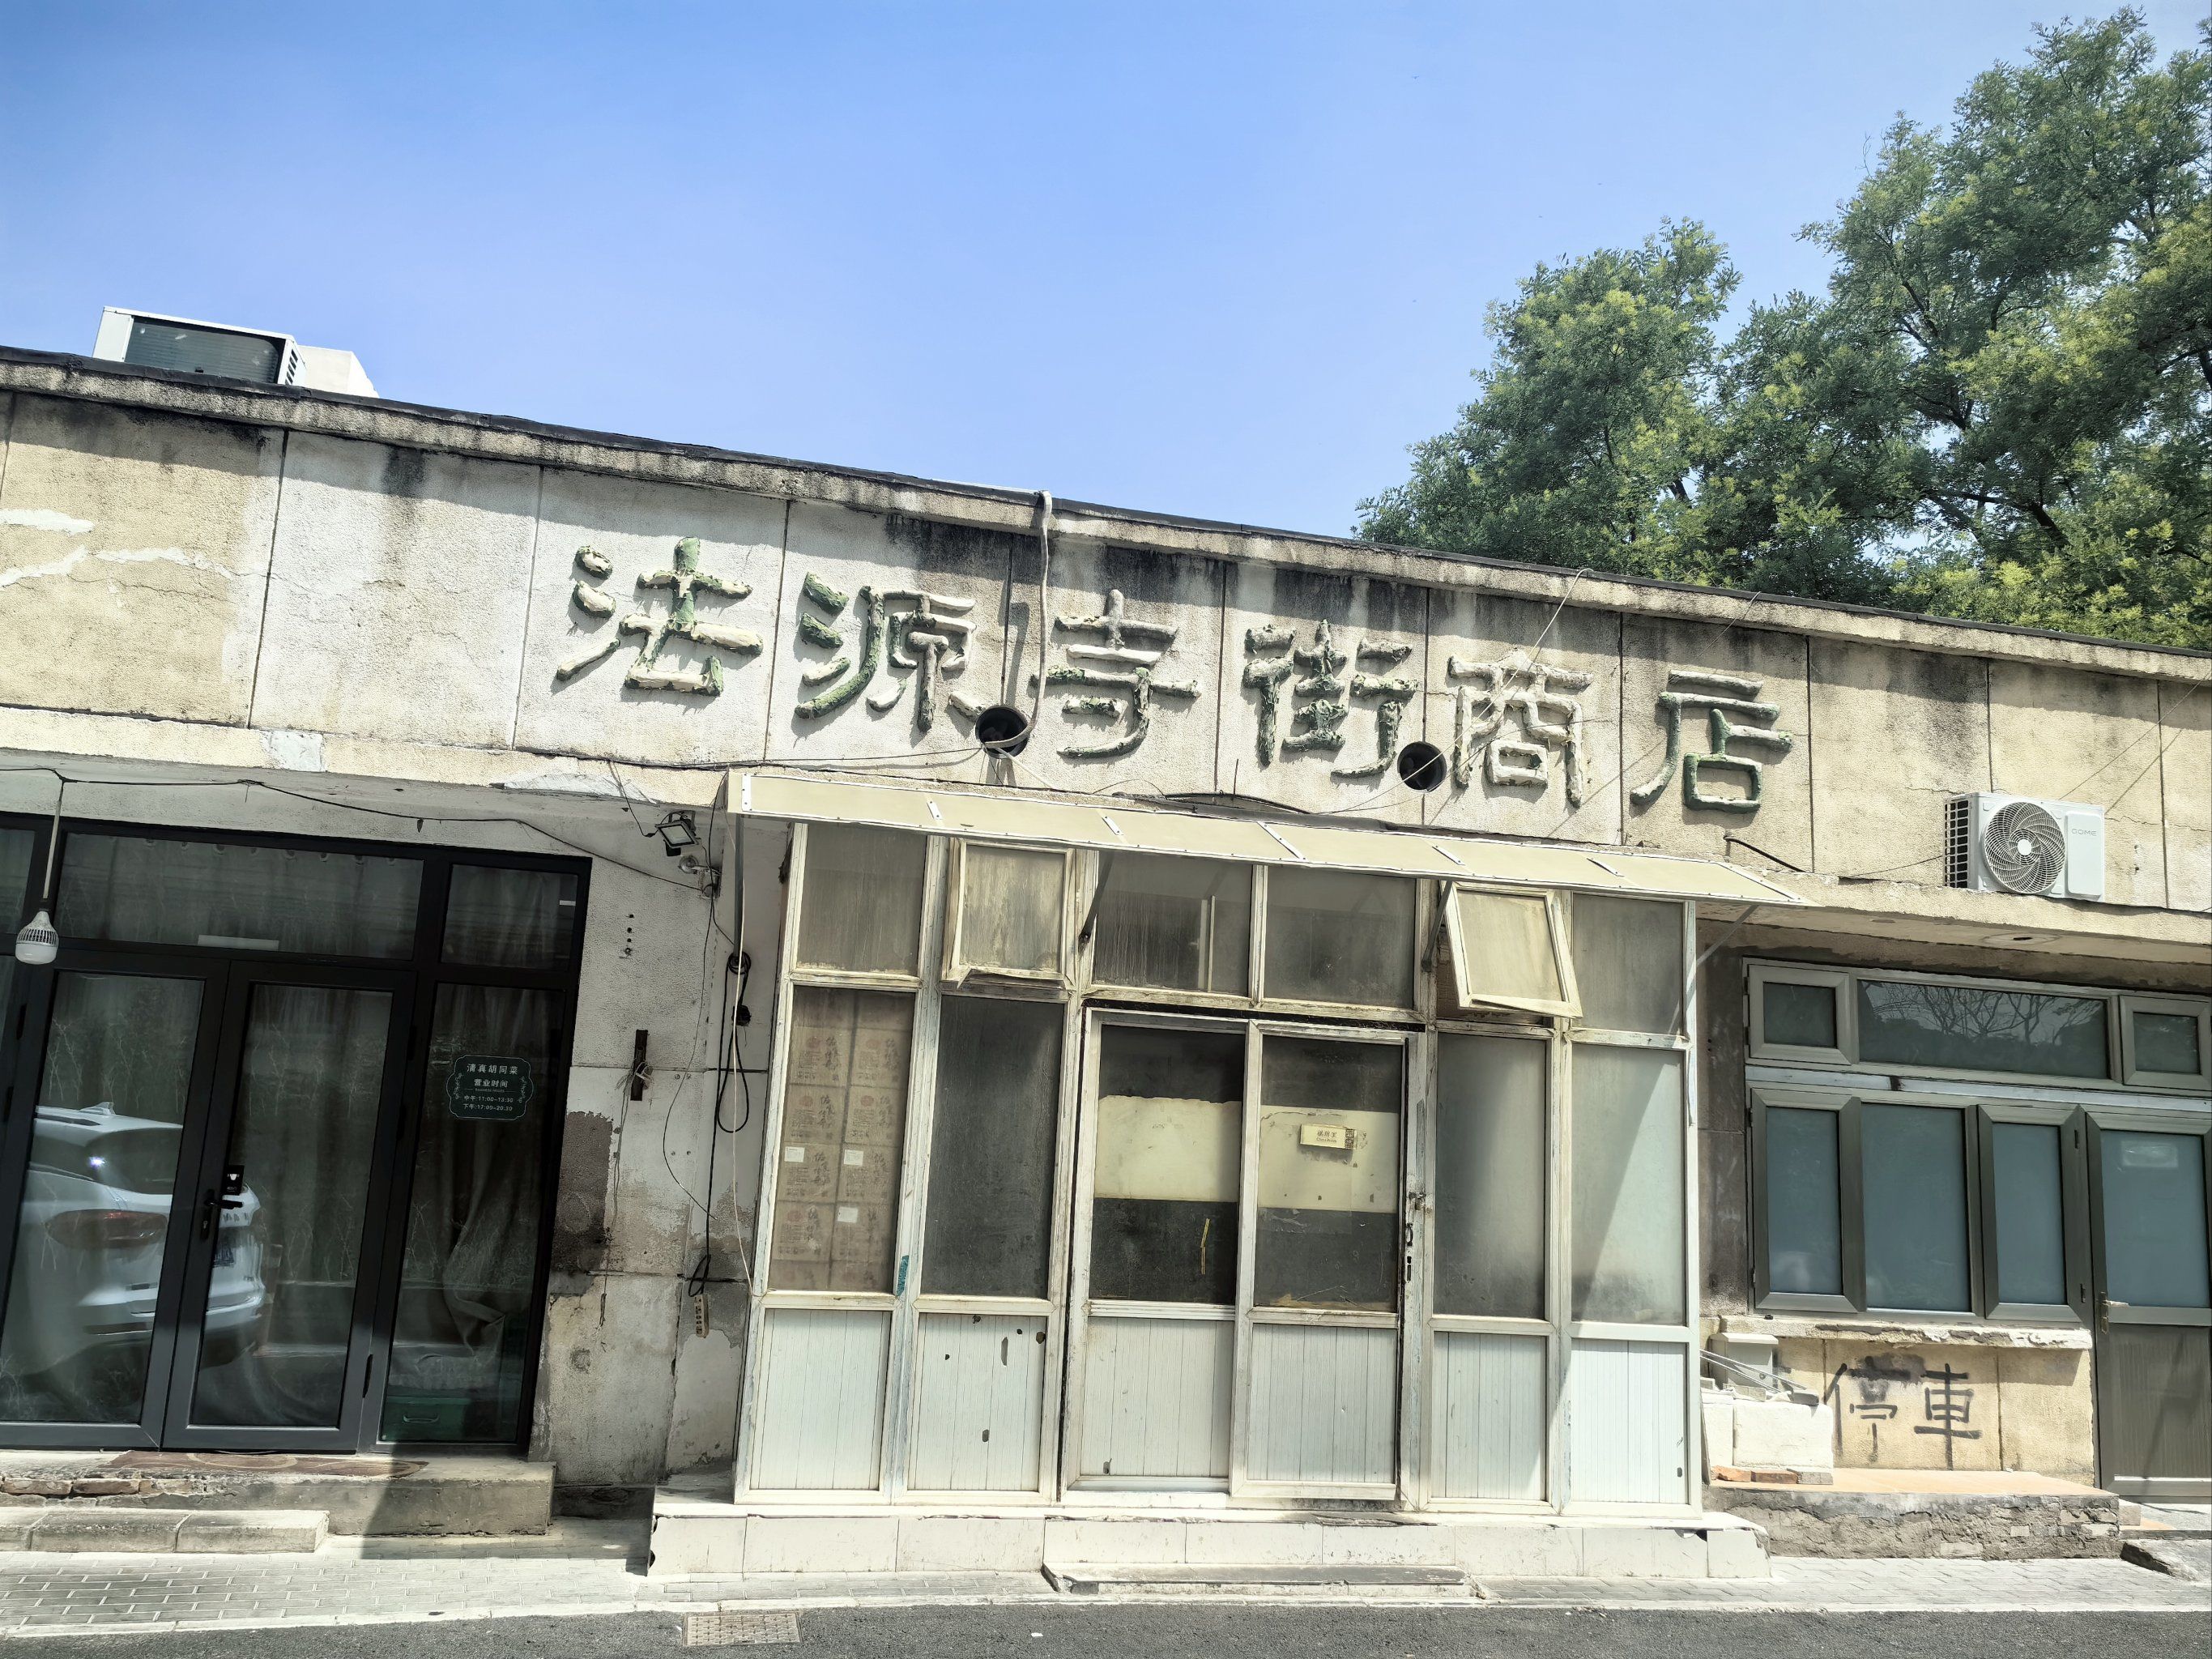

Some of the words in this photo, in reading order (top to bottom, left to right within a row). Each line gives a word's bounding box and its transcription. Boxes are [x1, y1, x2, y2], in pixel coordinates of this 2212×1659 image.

[556, 536, 1793, 813] 法源寺街商店
[467, 1064, 518, 1075] 清真胡同菜
[474, 1078, 509, 1088] 营业时间
